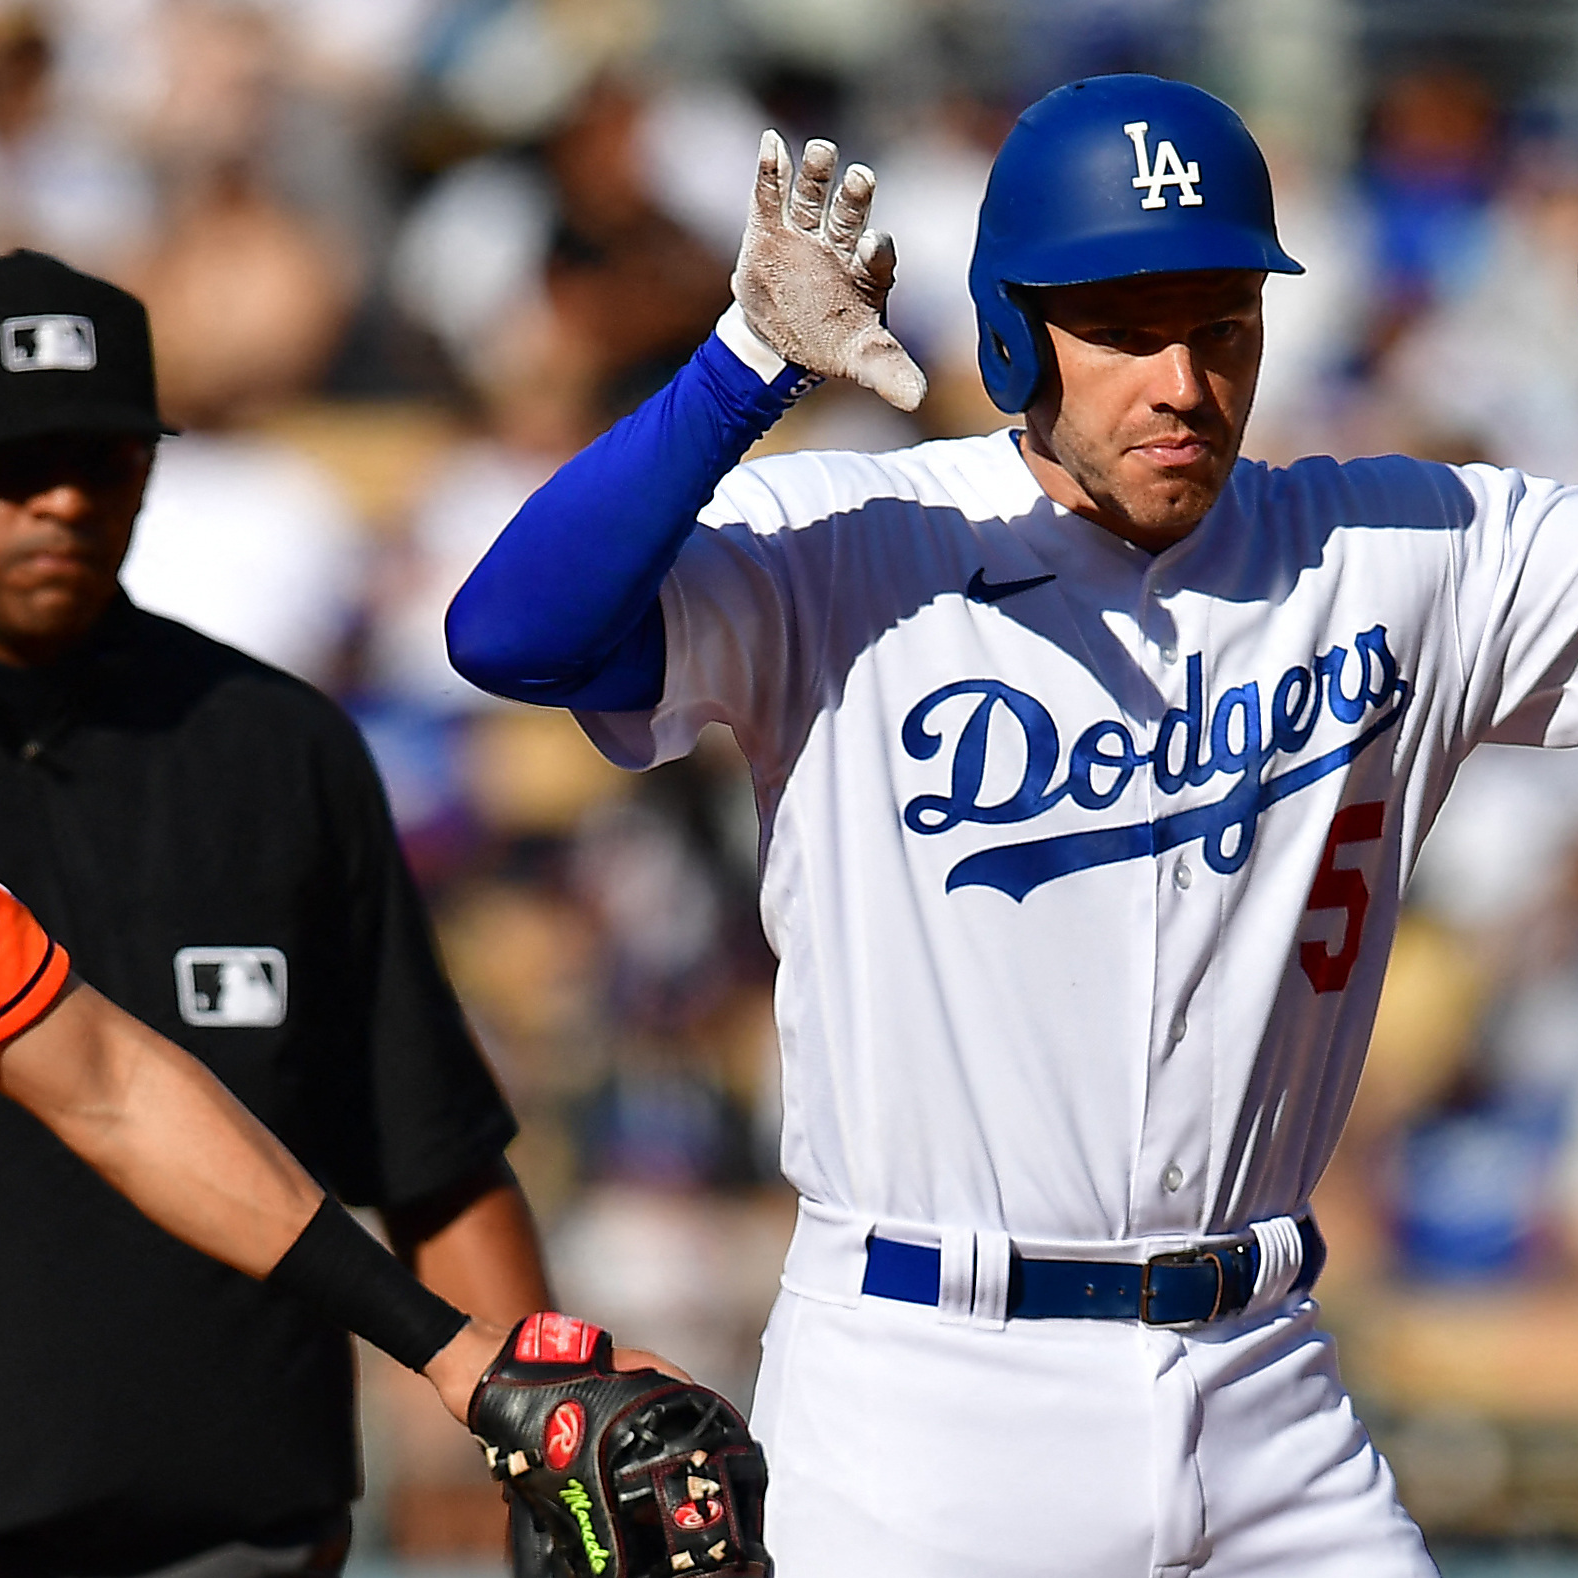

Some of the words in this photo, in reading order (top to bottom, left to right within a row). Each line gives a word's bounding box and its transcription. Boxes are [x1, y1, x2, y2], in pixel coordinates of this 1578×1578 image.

[1123, 121, 1203, 210] LA
[901, 622, 1411, 878] Dodgers
[1298, 799, 1386, 995] 5
